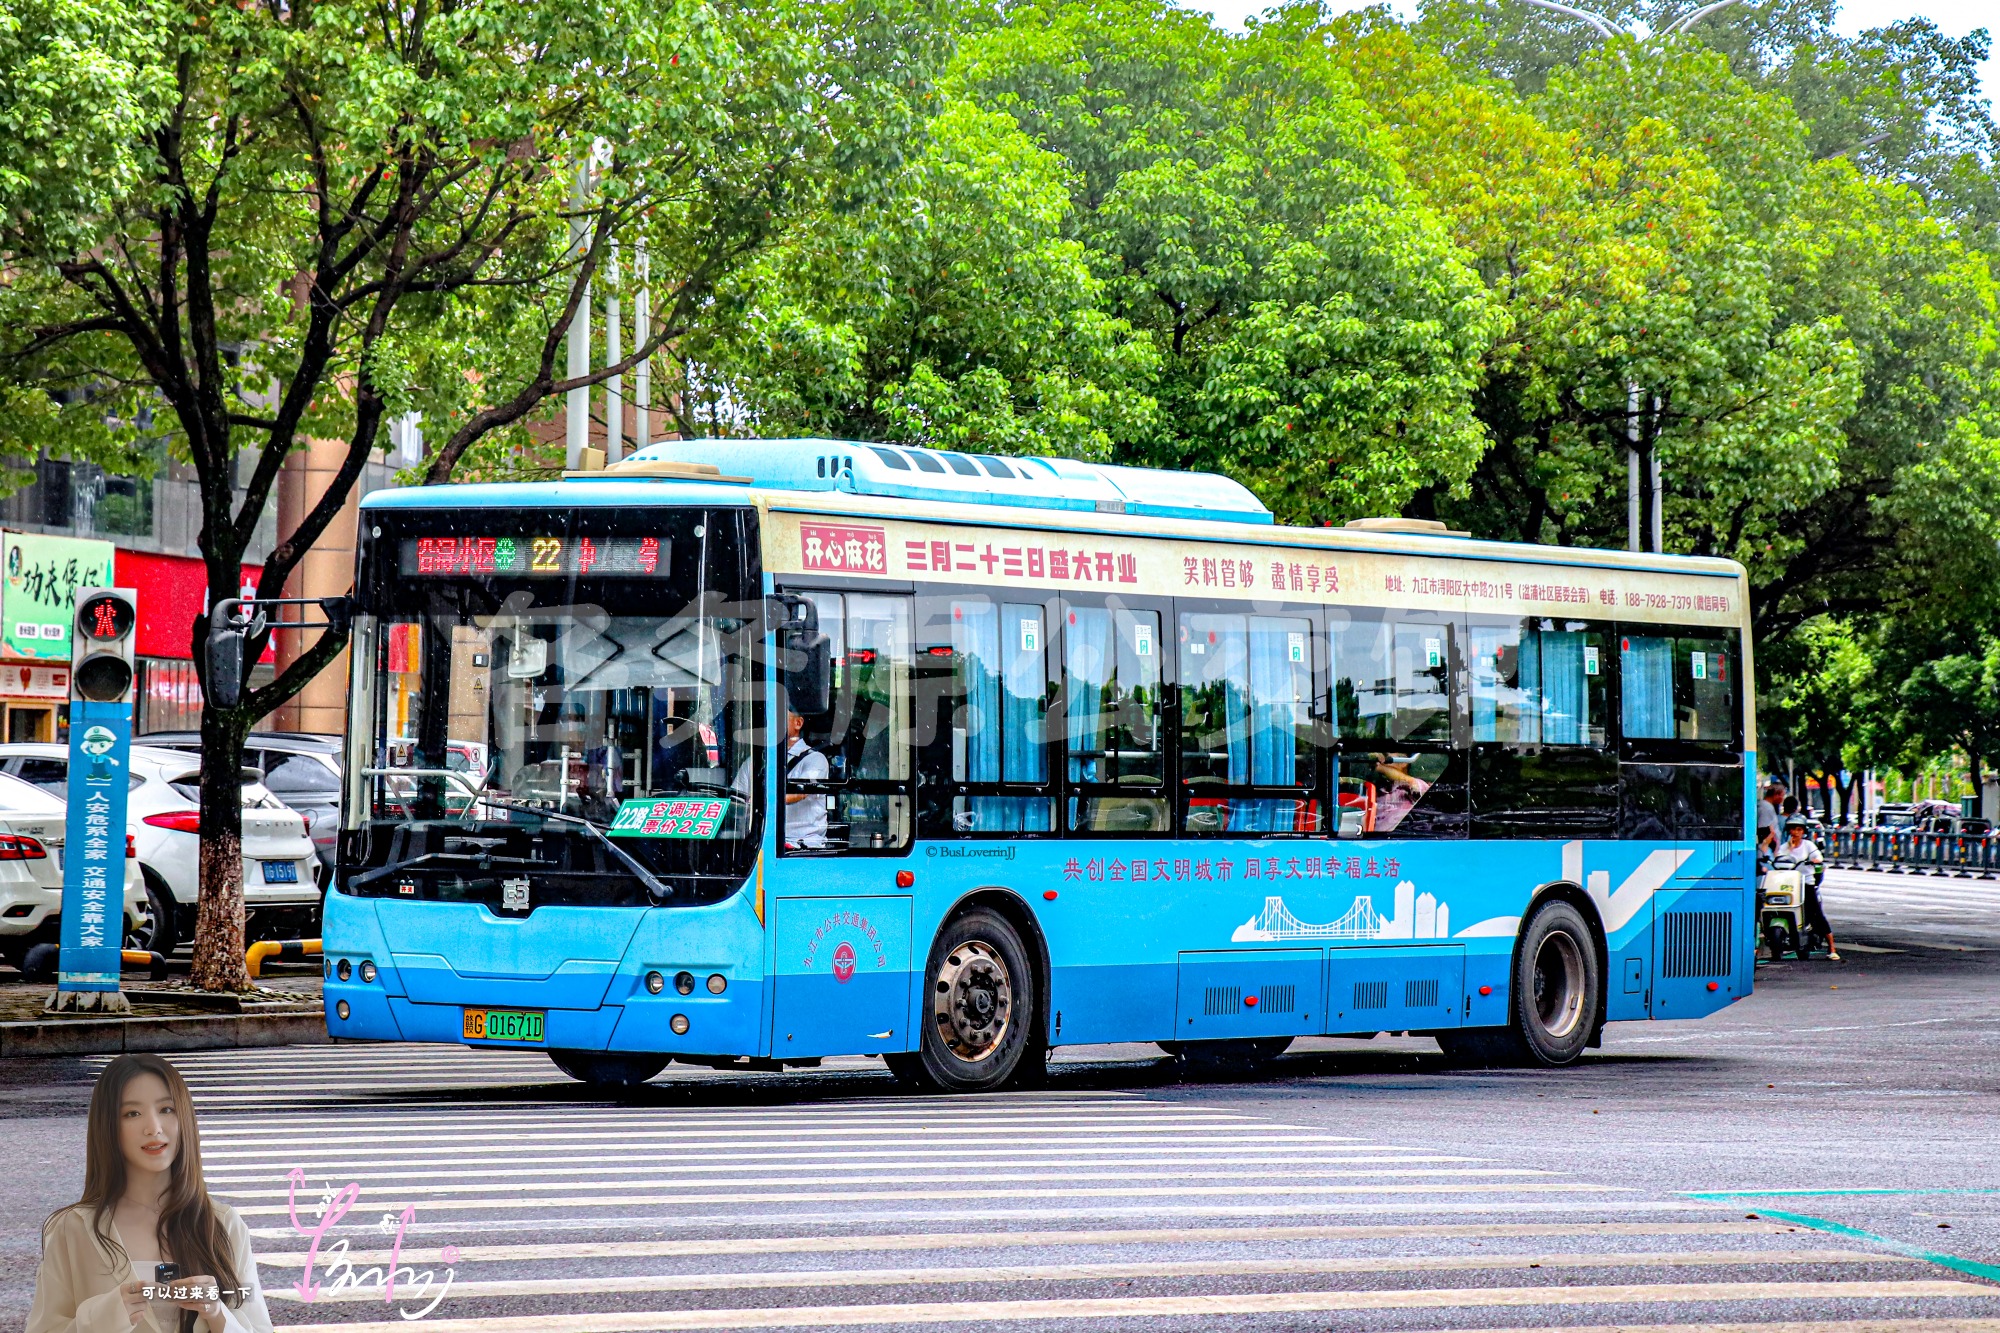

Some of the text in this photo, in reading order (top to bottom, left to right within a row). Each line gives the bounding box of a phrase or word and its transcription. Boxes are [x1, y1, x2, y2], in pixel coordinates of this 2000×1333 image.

[532, 539, 560, 571] 22
[805, 537, 884, 571] 开心麻花
[905, 540, 1138, 583] 三月二十三日盛大开业
[1183, 556, 1339, 593] 笑料管够 盡情享受
[615, 807, 649, 829] 22路
[649, 801, 722, 819] 空调开启
[641, 819, 714, 836] 票价2元
[1063, 856, 1401, 882] 共创全国文明城市 同享文明幸福生活
[80, 866, 107, 947] 交通安全靠大家
